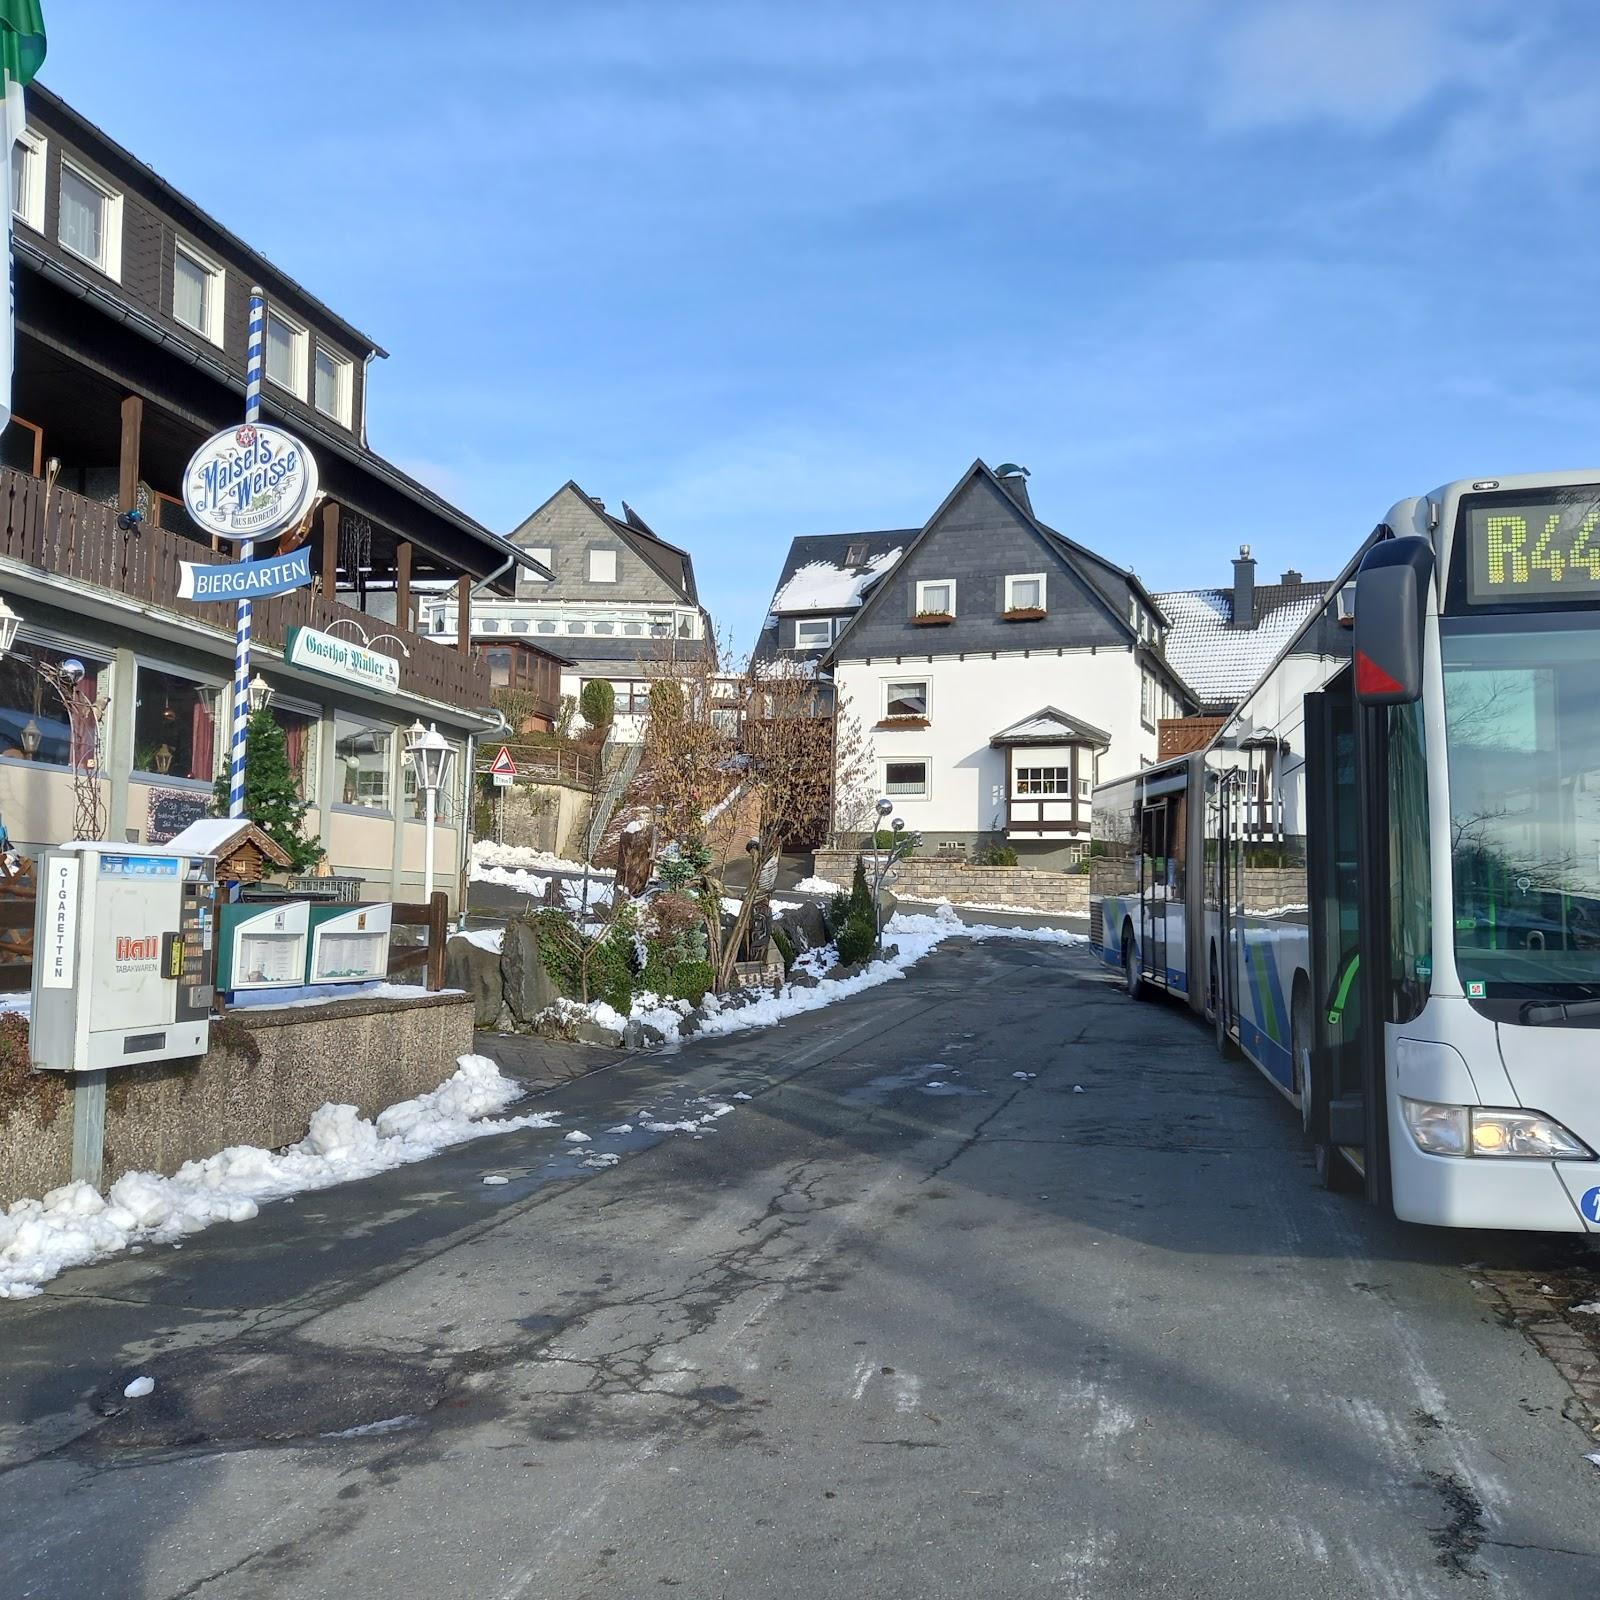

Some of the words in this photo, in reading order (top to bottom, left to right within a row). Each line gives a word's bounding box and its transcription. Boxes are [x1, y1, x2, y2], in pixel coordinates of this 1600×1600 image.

[196, 432, 272, 512] Maisel's
[229, 450, 296, 511] Weisse
[234, 517, 247, 527] AUS
[247, 504, 279, 525] BAYREUTH
[1487, 512, 1600, 585] R44
[196, 559, 307, 594] BIERGARTEN
[306, 634, 348, 669] Gasthof
[54, 867, 69, 978] CIGARETTEN
[116, 935, 159, 961] Hall
[115, 963, 158, 974] TABAKWAREN
